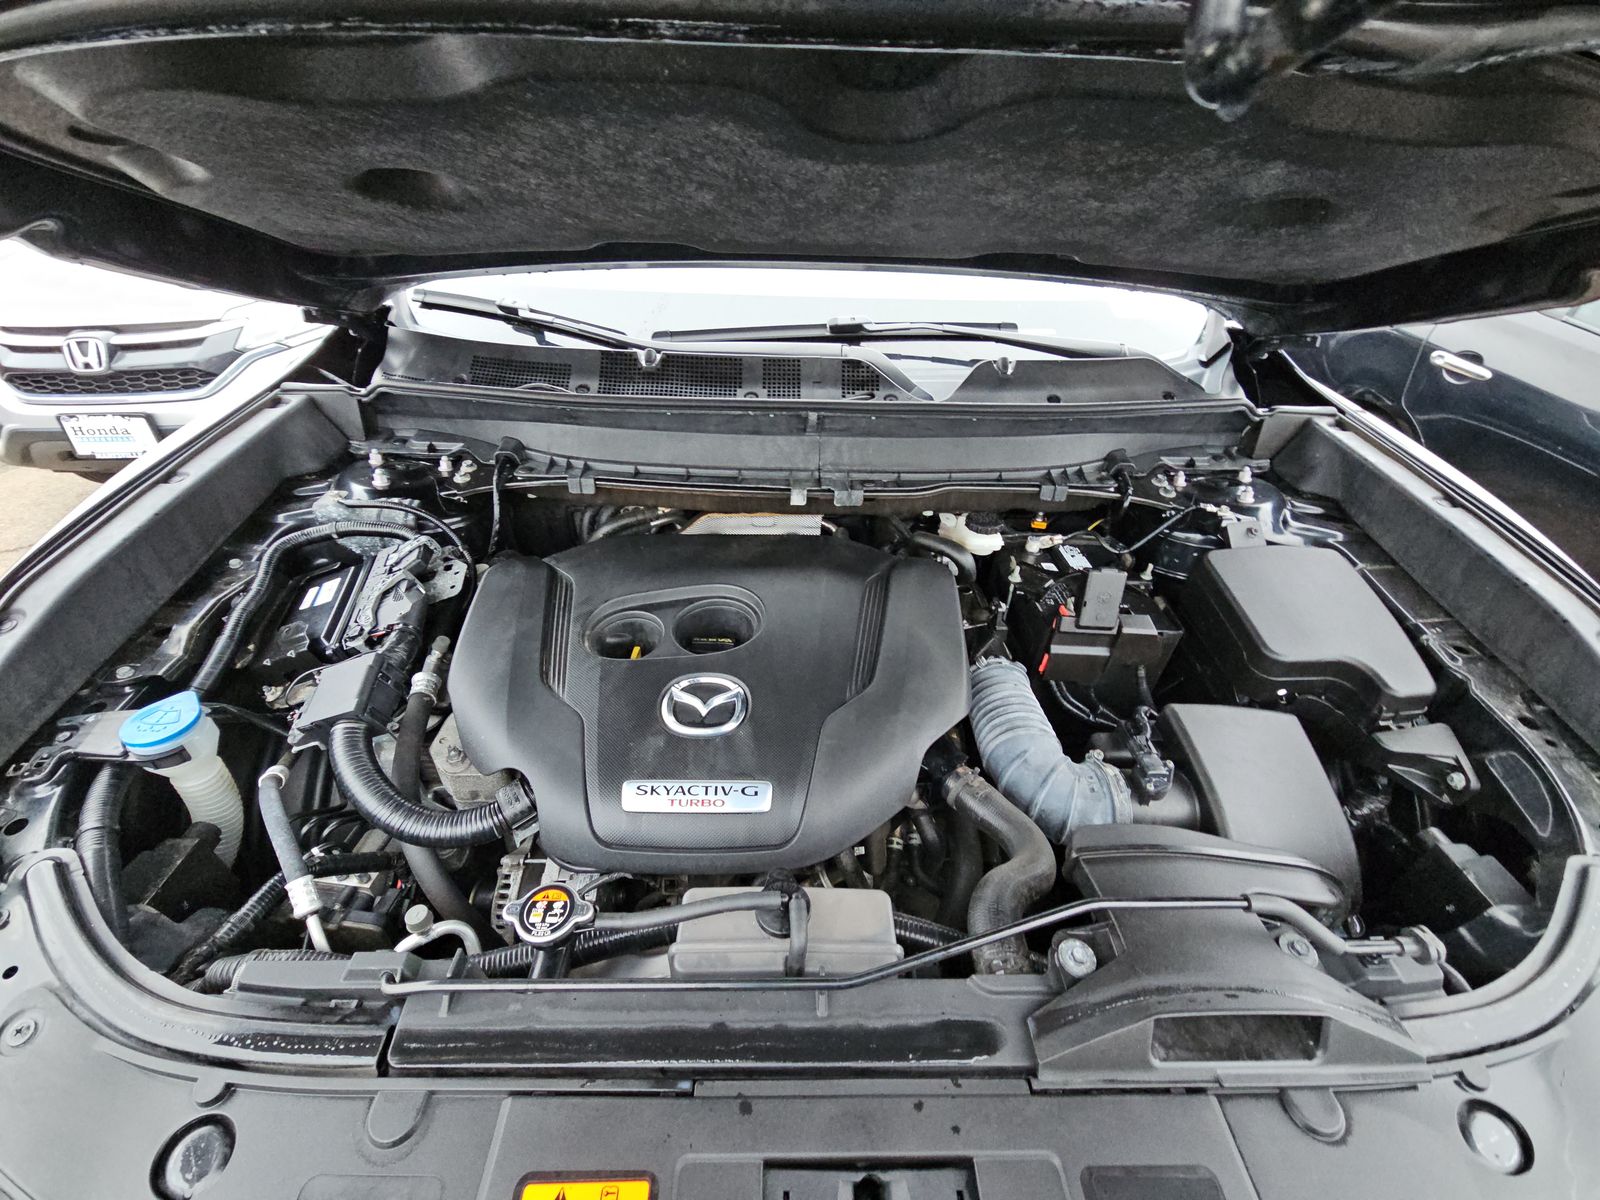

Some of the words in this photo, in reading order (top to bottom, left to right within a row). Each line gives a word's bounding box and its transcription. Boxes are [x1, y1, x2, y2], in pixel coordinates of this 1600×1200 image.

[71, 426, 131, 436] Honda
[635, 784, 759, 797] SKYACTIV-G
[667, 798, 725, 808] TURBO
